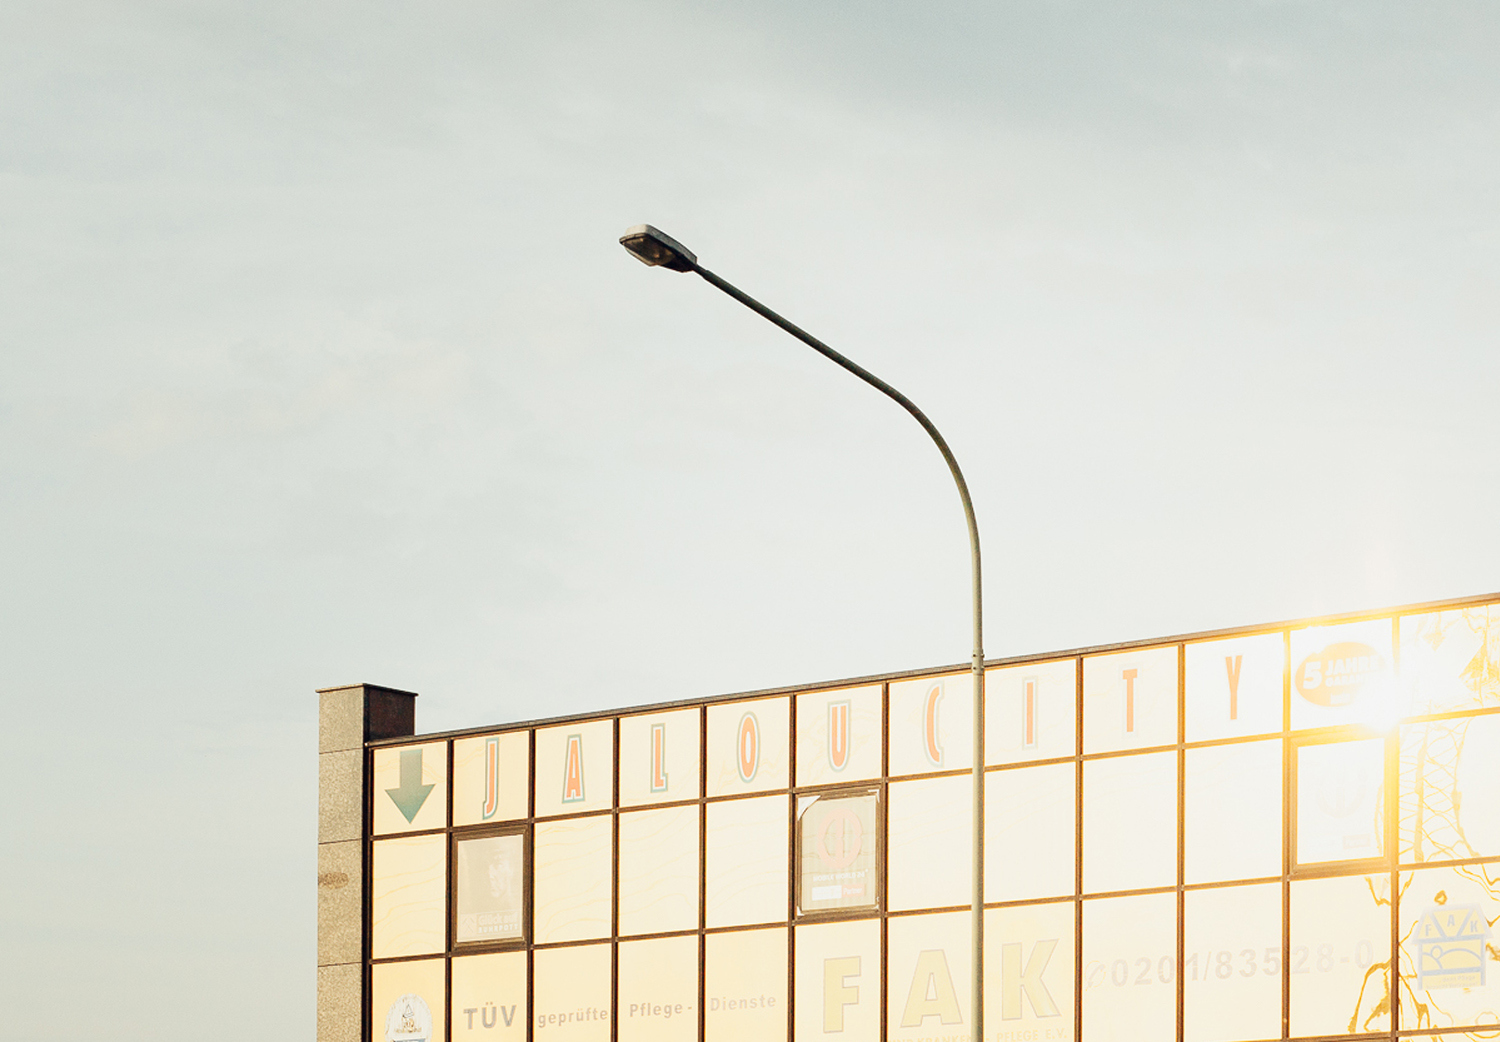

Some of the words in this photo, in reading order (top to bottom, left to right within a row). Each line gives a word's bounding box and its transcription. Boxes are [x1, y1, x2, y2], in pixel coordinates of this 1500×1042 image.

[1302, 660, 1322, 690] 5
[1111, 939, 1374, 988] 0201/83528-0
[823, 938, 1062, 1034] FAK
[463, 1001, 517, 1031] TÜV
[537, 1006, 609, 1029] geprüfte
[710, 994, 777, 1012] Dienste
